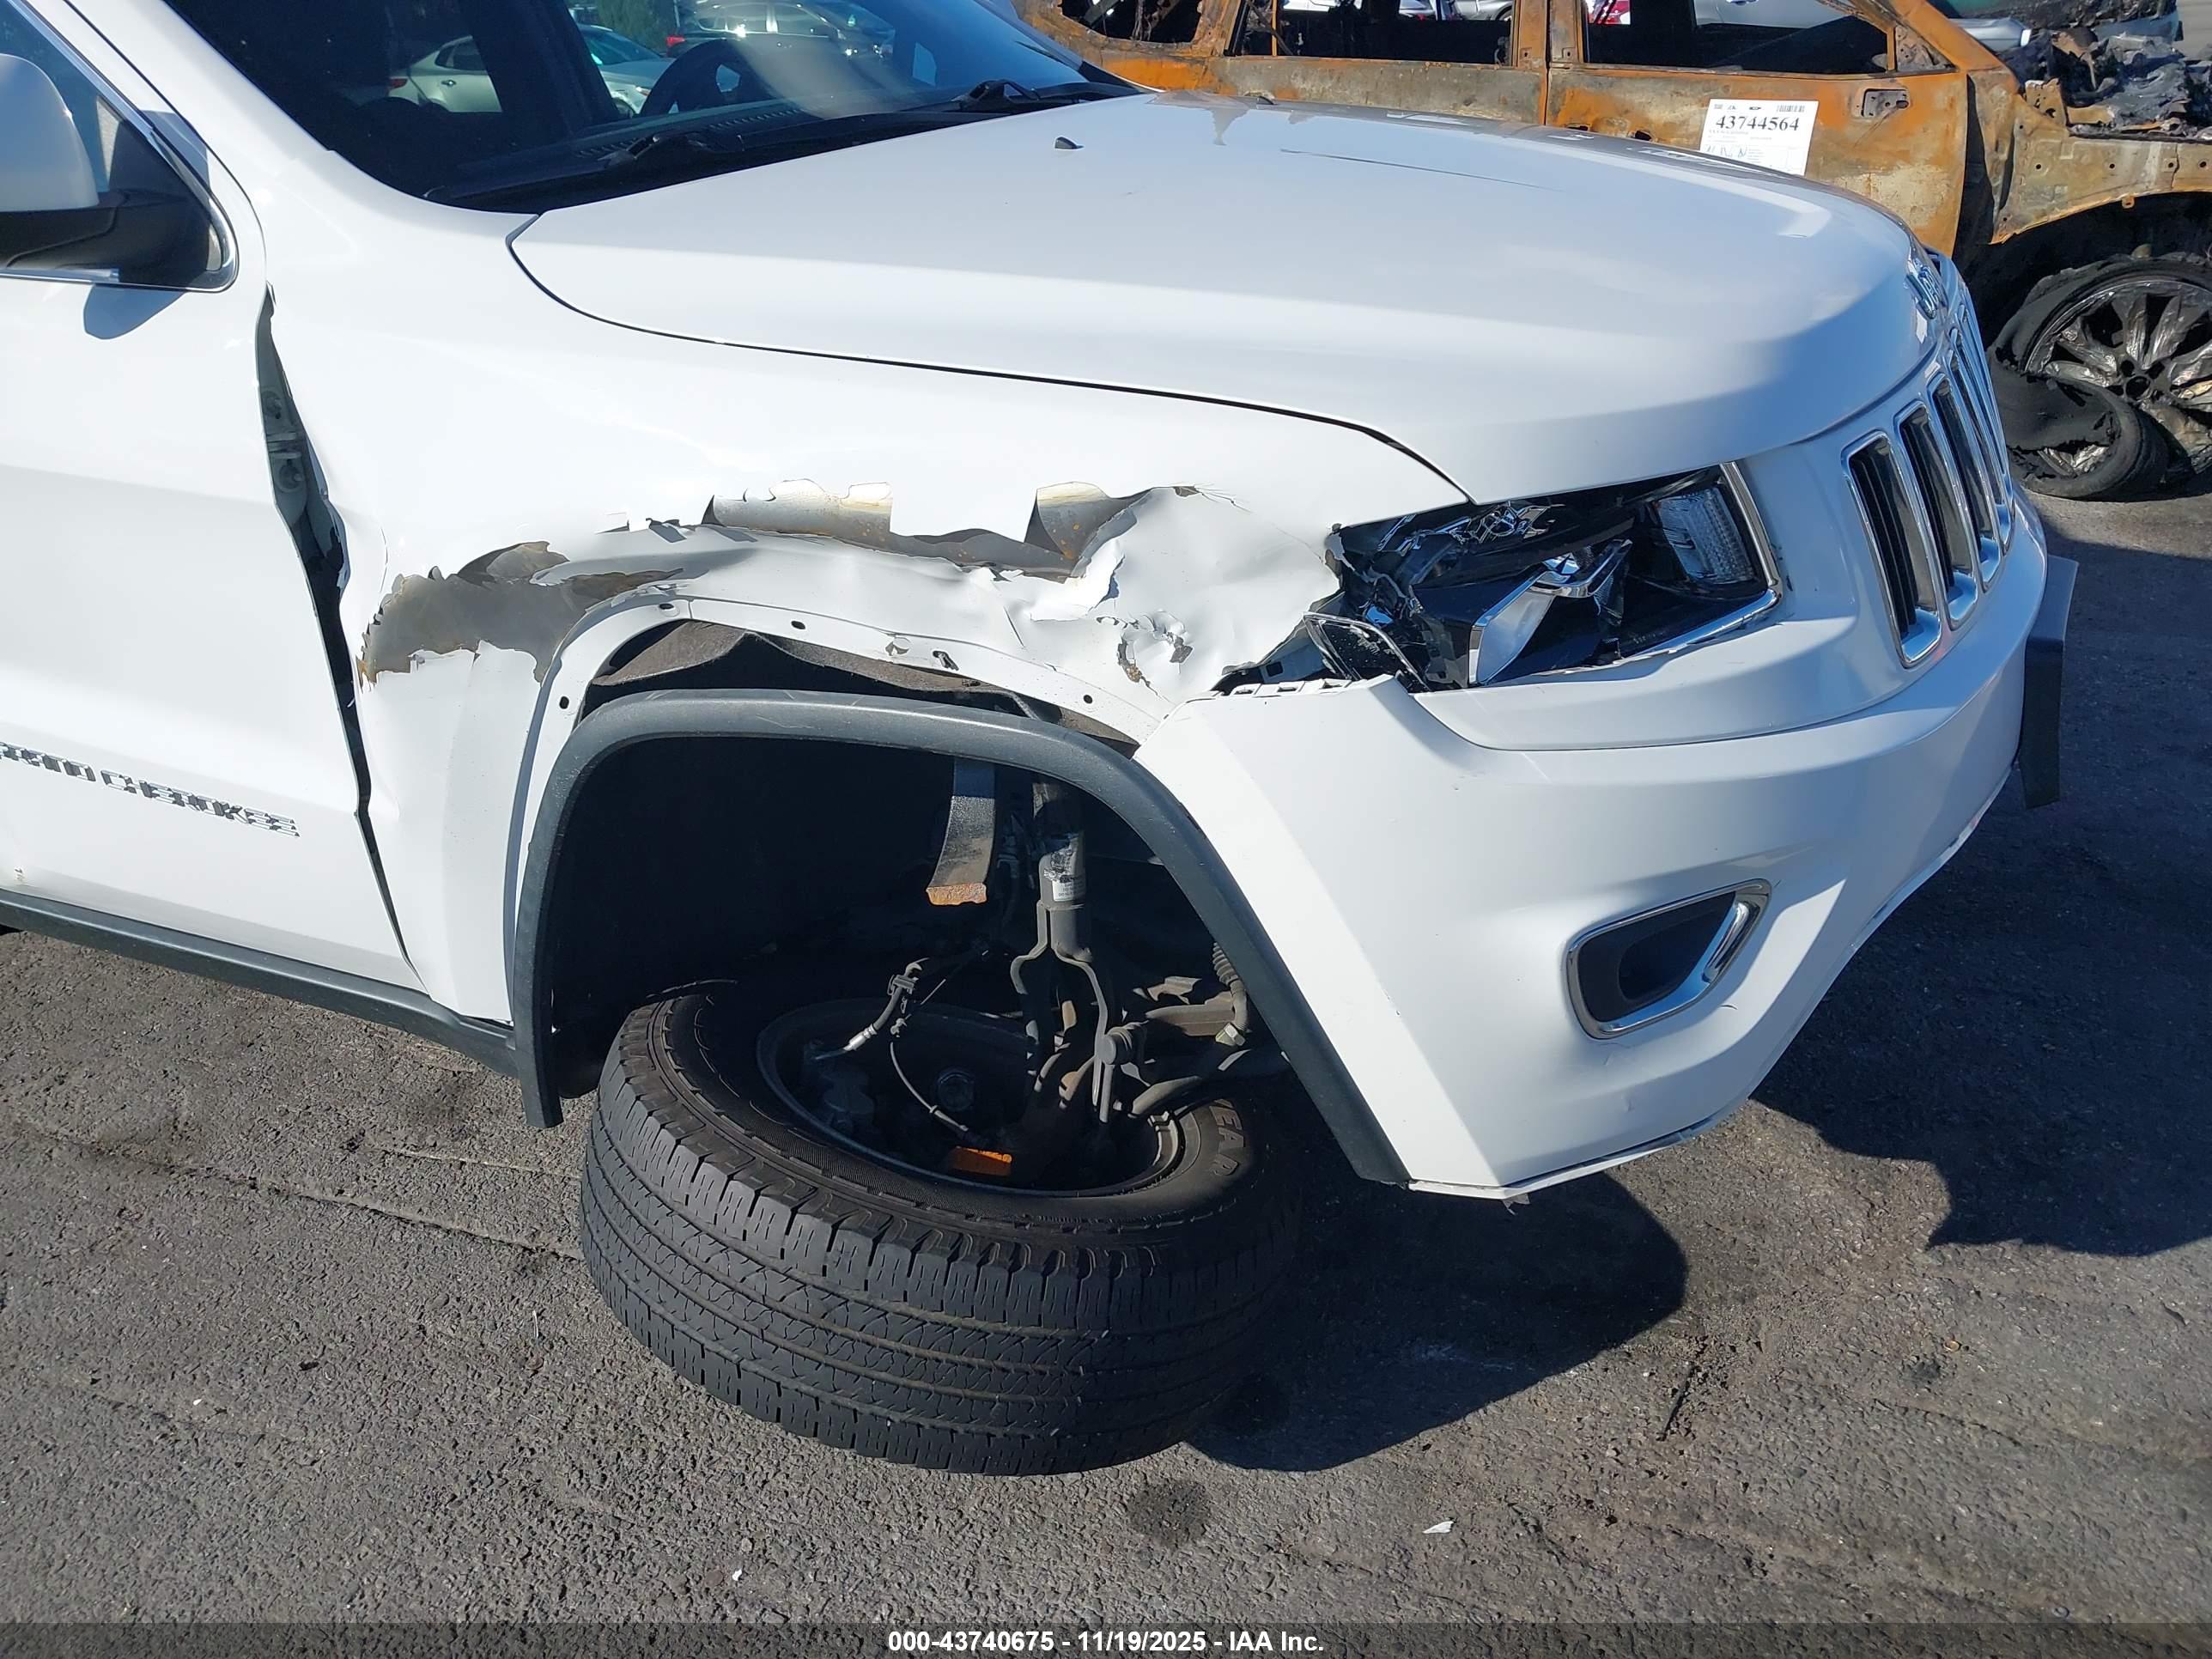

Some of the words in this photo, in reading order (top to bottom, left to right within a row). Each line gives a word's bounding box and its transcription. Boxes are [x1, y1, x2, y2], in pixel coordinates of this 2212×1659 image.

[1716, 114, 1800, 131] 43744564
[0, 741, 96, 782] RAND
[100, 769, 301, 838] CHEROKEE
